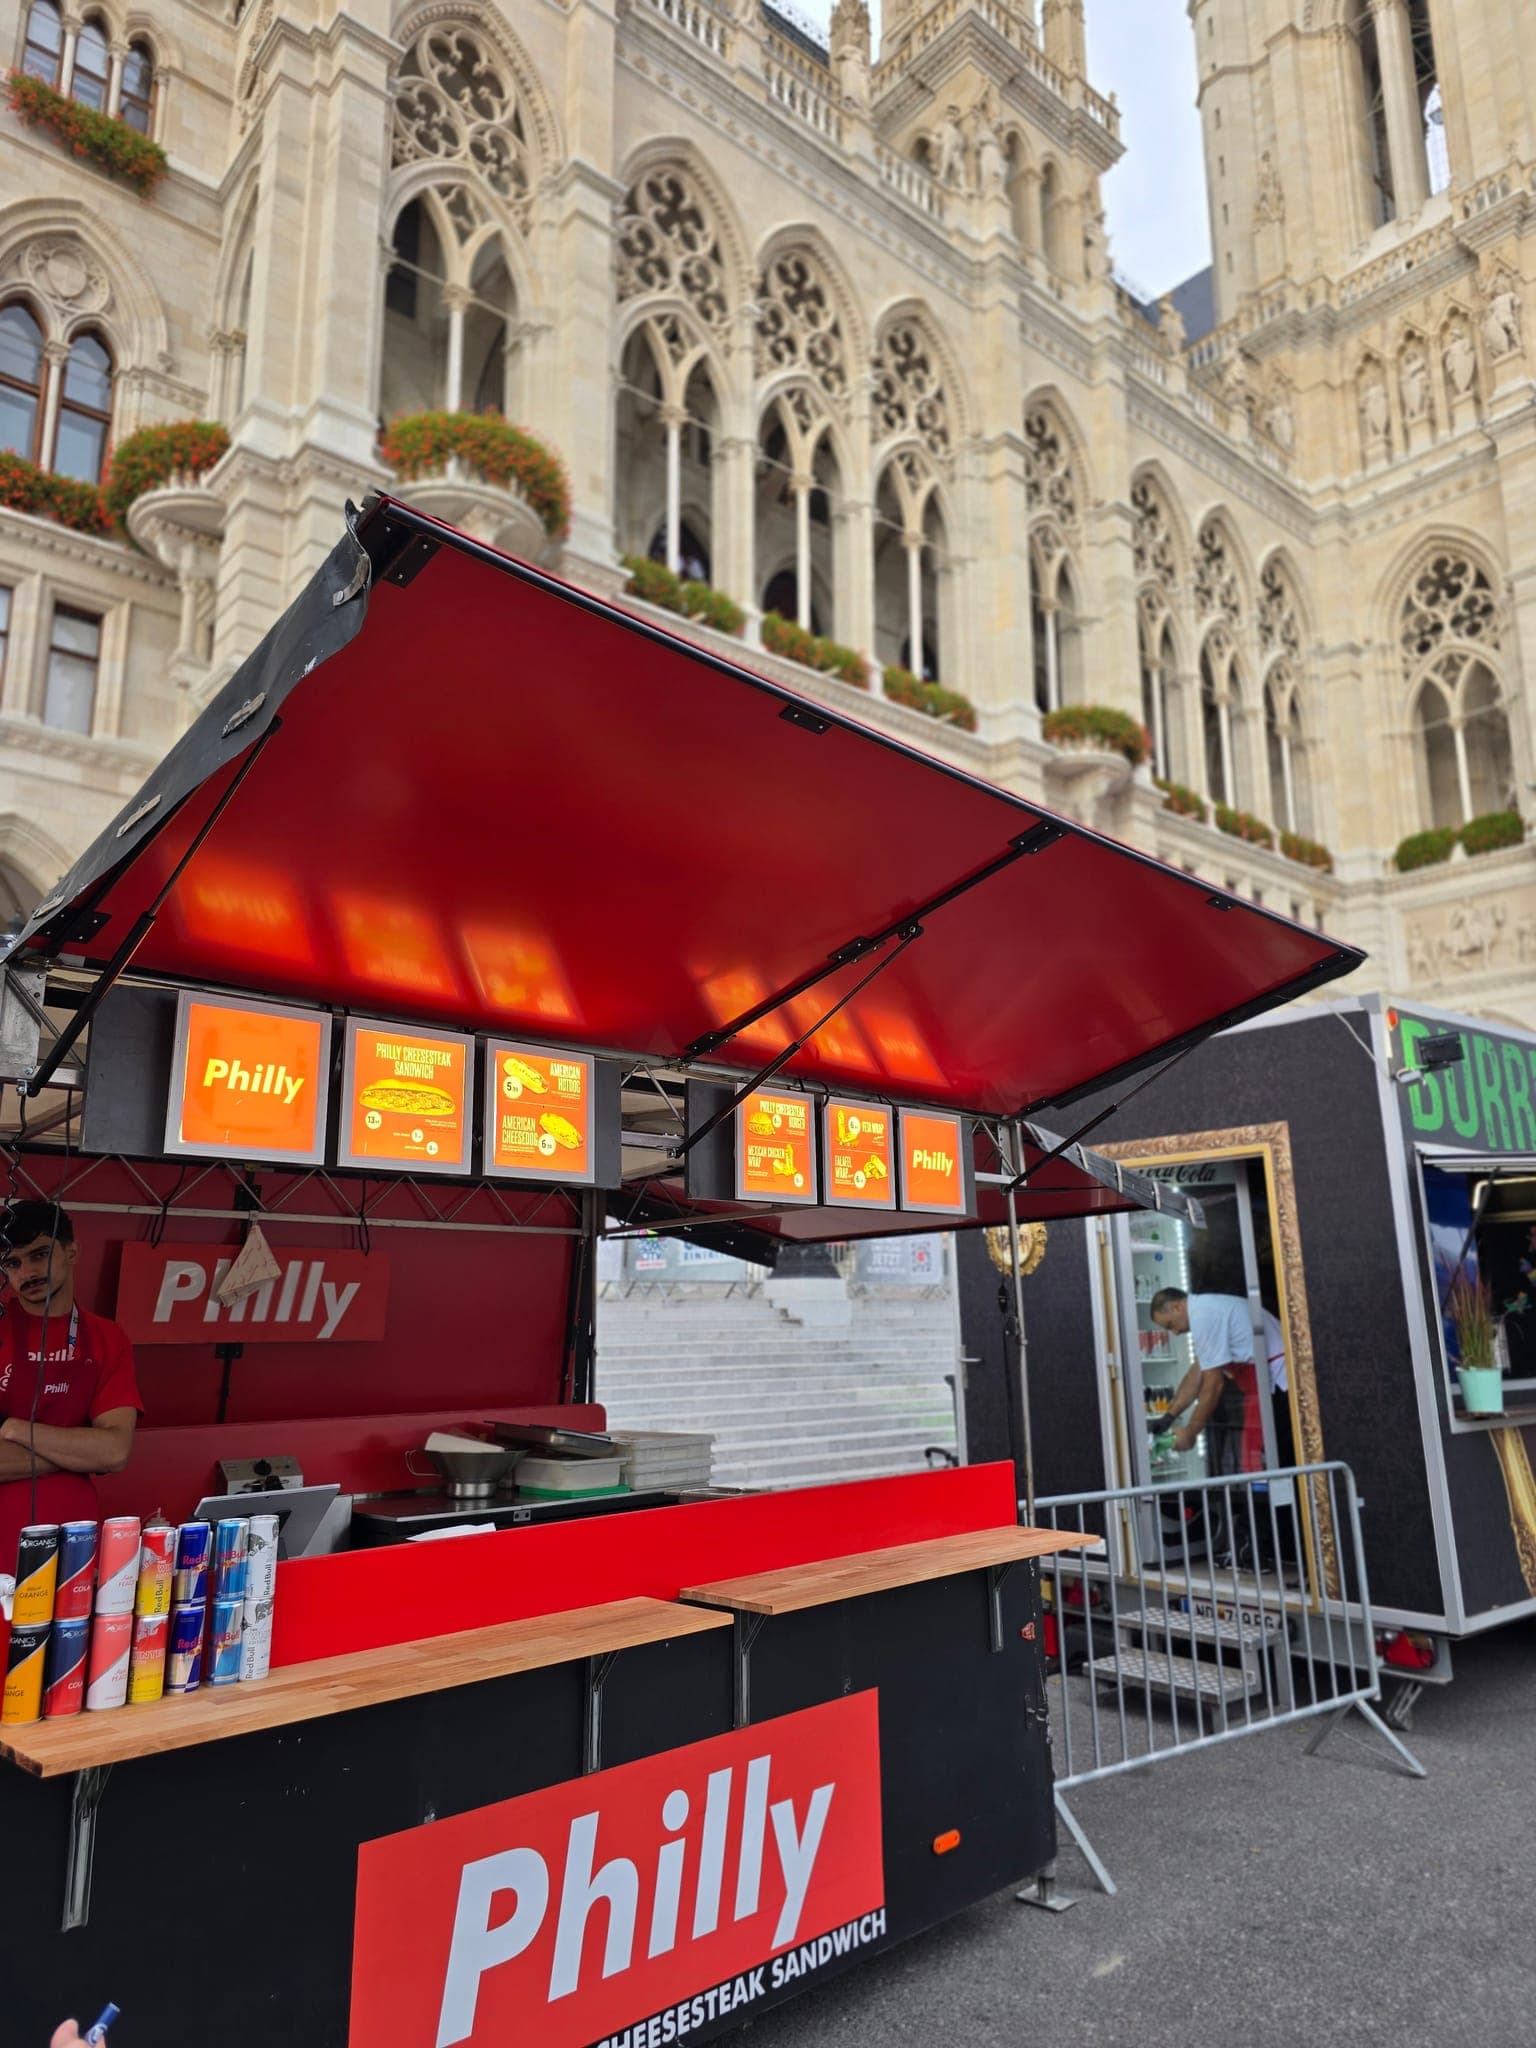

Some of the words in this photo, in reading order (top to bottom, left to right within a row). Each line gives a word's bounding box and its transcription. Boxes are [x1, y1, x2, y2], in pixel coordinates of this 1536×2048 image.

[376, 1042, 402, 1060] PHILLY
[403, 1046, 452, 1067] CHEESESTEAK
[203, 1057, 305, 1105] Philly
[394, 1061, 434, 1080] SANDWICH
[1400, 1018, 1536, 1150] BURR
[502, 1114, 536, 1132] AMERICAN
[502, 1130, 539, 1147] CHEESEDOG
[912, 1149, 954, 1177] Philly
[44, 1382, 70, 1394] Philly
[435, 1754, 835, 2048] Philly
[772, 1907, 887, 1989] SANDWICH
